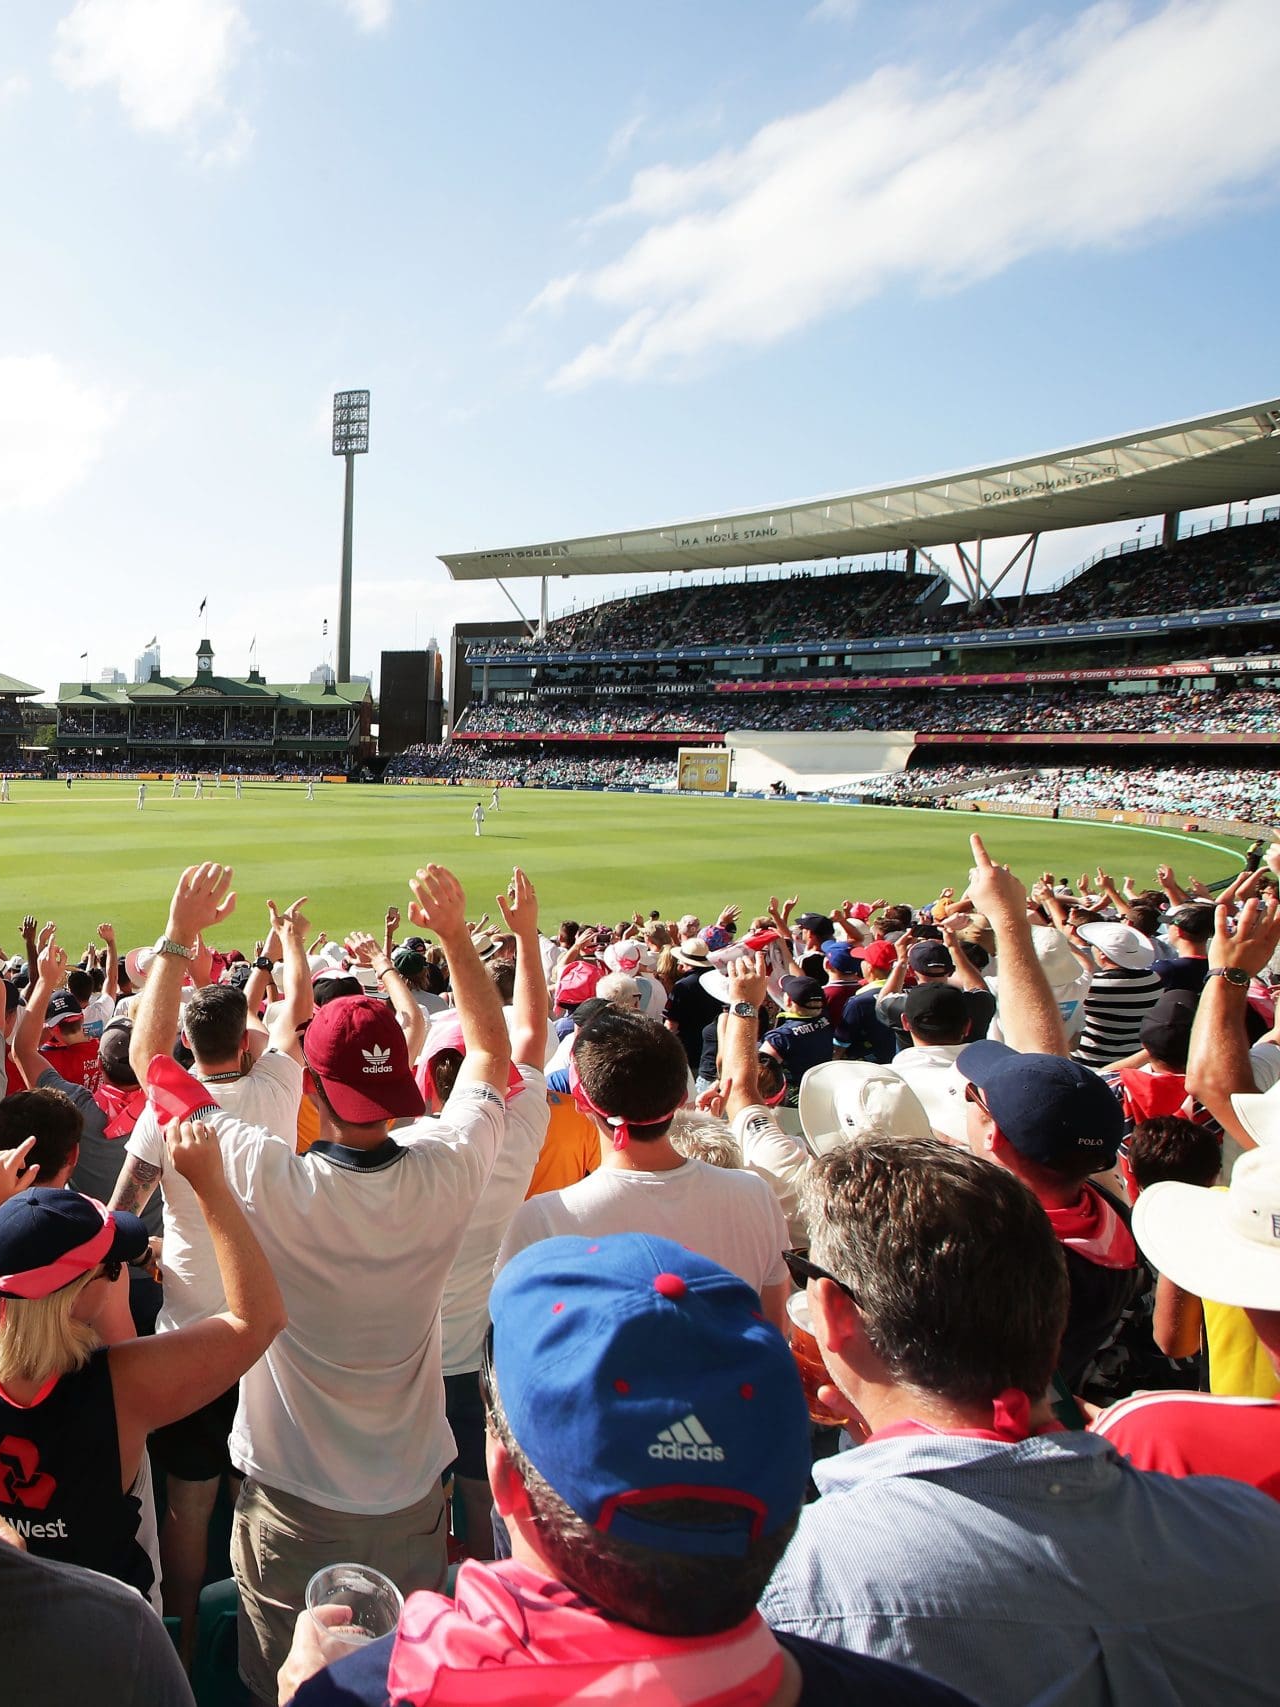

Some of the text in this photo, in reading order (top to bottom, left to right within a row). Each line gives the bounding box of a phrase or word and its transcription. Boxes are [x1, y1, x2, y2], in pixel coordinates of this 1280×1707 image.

[984, 491, 1010, 502] DON
[744, 528, 778, 539] STAND
[1176, 665, 1207, 674] TOYOTA
[1246, 660, 1269, 670] YOUR
[1127, 668, 1158, 676] TOYOTA
[1072, 808, 1097, 818] BEER
[792, 1022, 815, 1036] PORT
[362, 1064, 393, 1074] adidas
[1078, 1138, 1103, 1146] POLO
[648, 1443, 725, 1462] adidas
[4, 1517, 69, 1538] West
